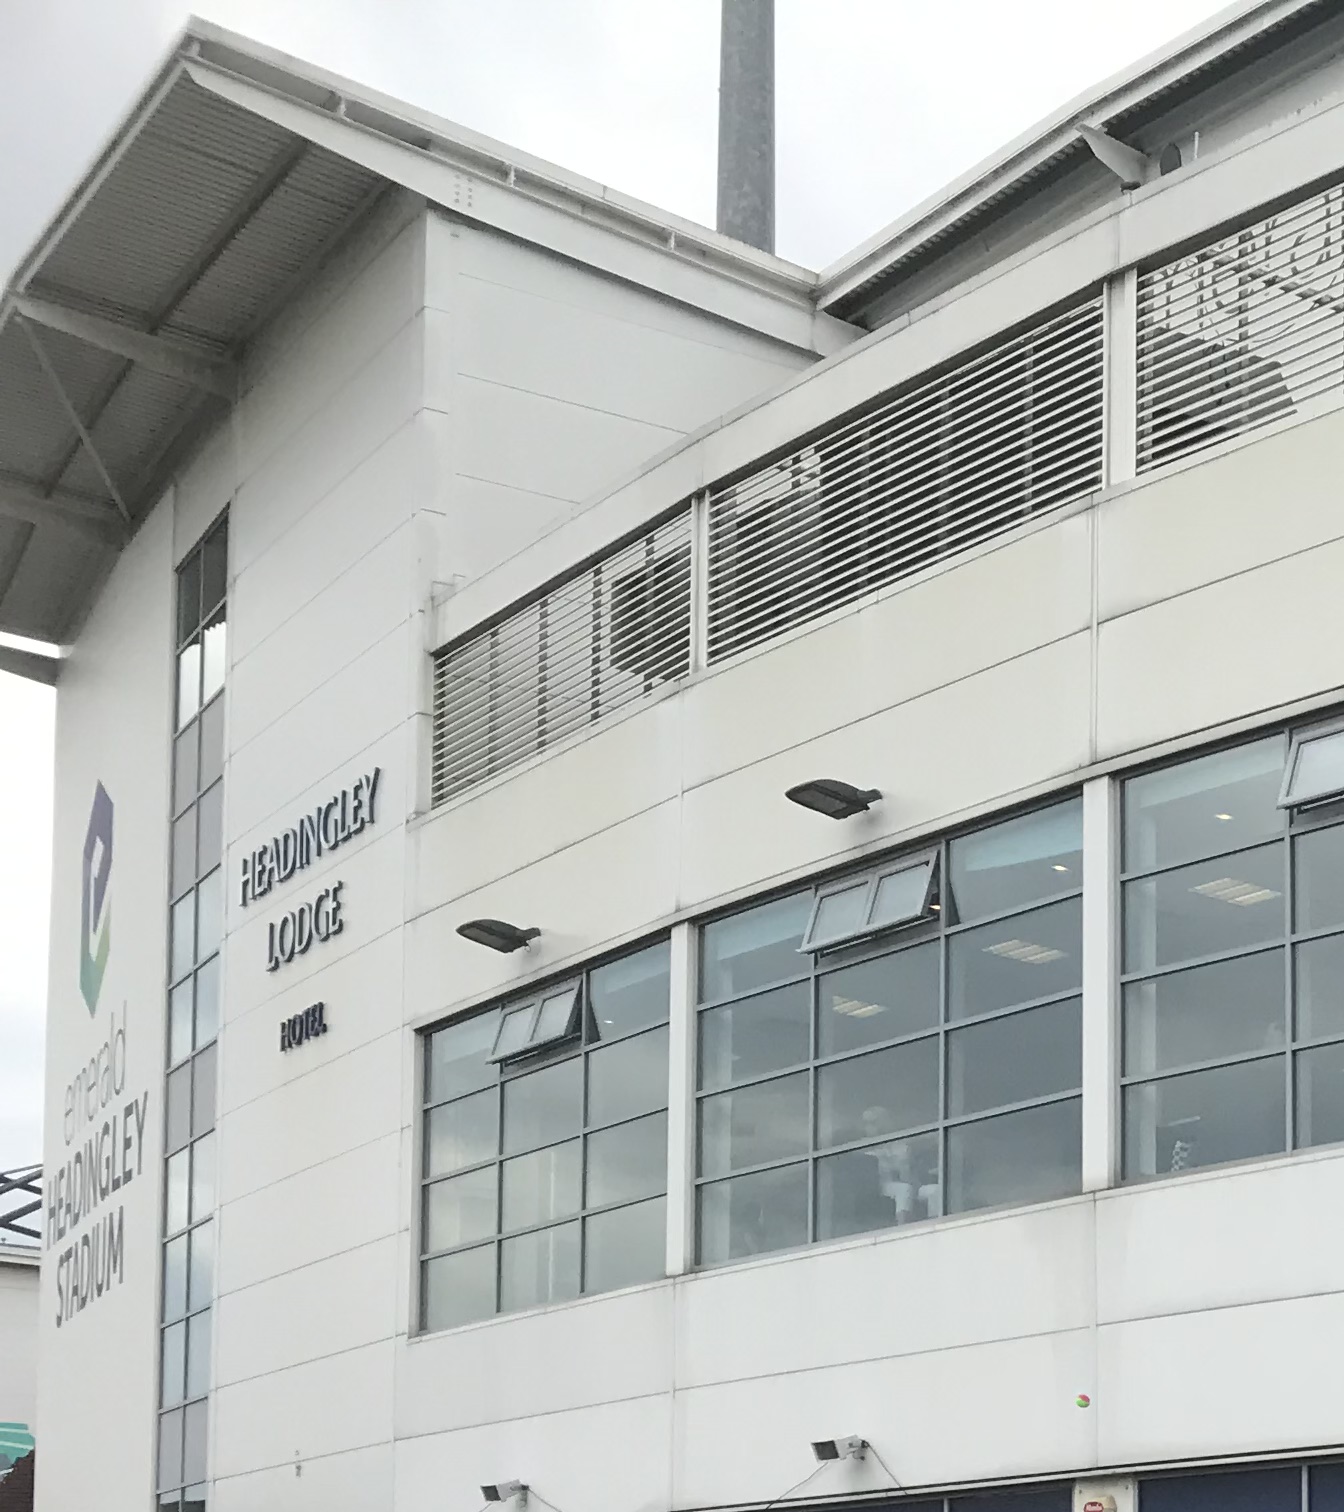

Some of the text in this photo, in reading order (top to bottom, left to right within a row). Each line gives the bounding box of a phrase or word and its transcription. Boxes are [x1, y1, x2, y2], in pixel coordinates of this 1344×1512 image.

[239, 767, 381, 907] HEADINGLEY
[266, 881, 343, 972] LODGE
[64, 1000, 127, 1146] emerald
[279, 1001, 326, 1052] HOTEL
[47, 1091, 148, 1250] HEADINGLEY
[56, 1206, 124, 1328] STADIUM
